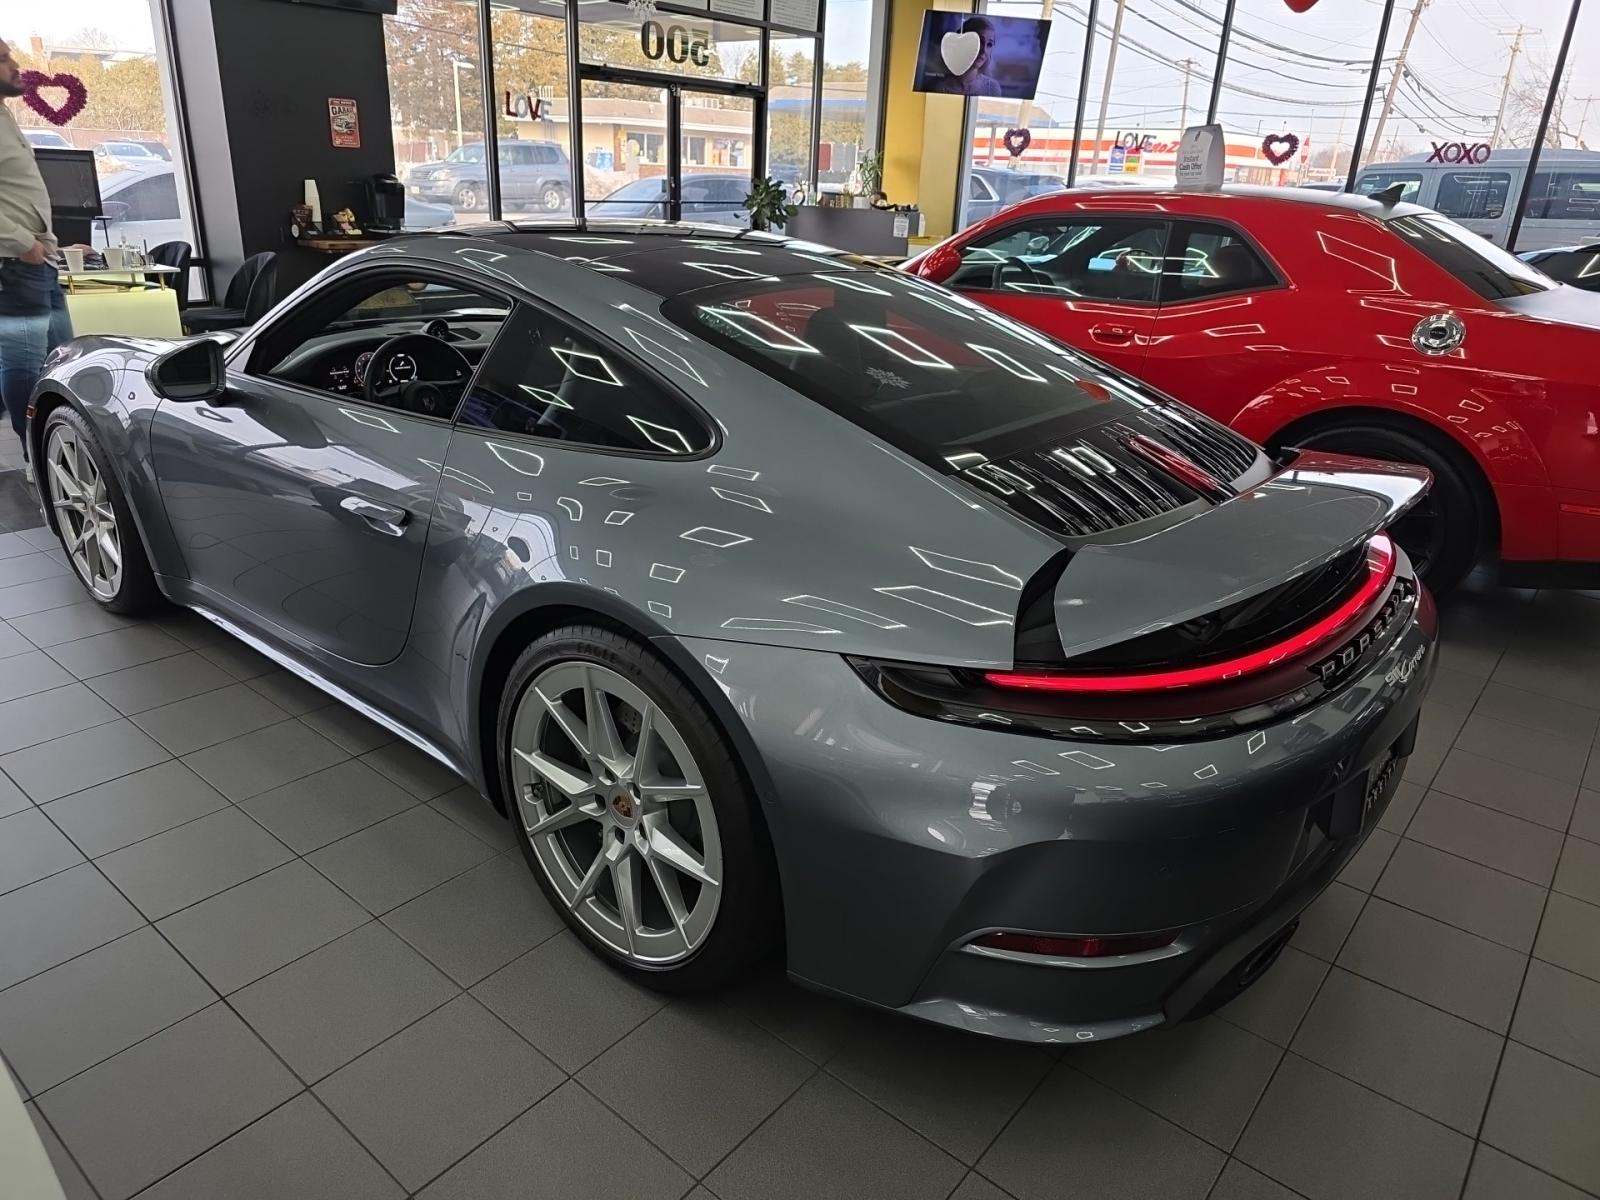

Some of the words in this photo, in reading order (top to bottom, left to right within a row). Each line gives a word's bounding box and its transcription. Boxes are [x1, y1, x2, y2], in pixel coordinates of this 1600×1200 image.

[505, 90, 553, 122] LOVE
[1114, 130, 1157, 153] LOVE
[1425, 141, 1491, 165] XOXO
